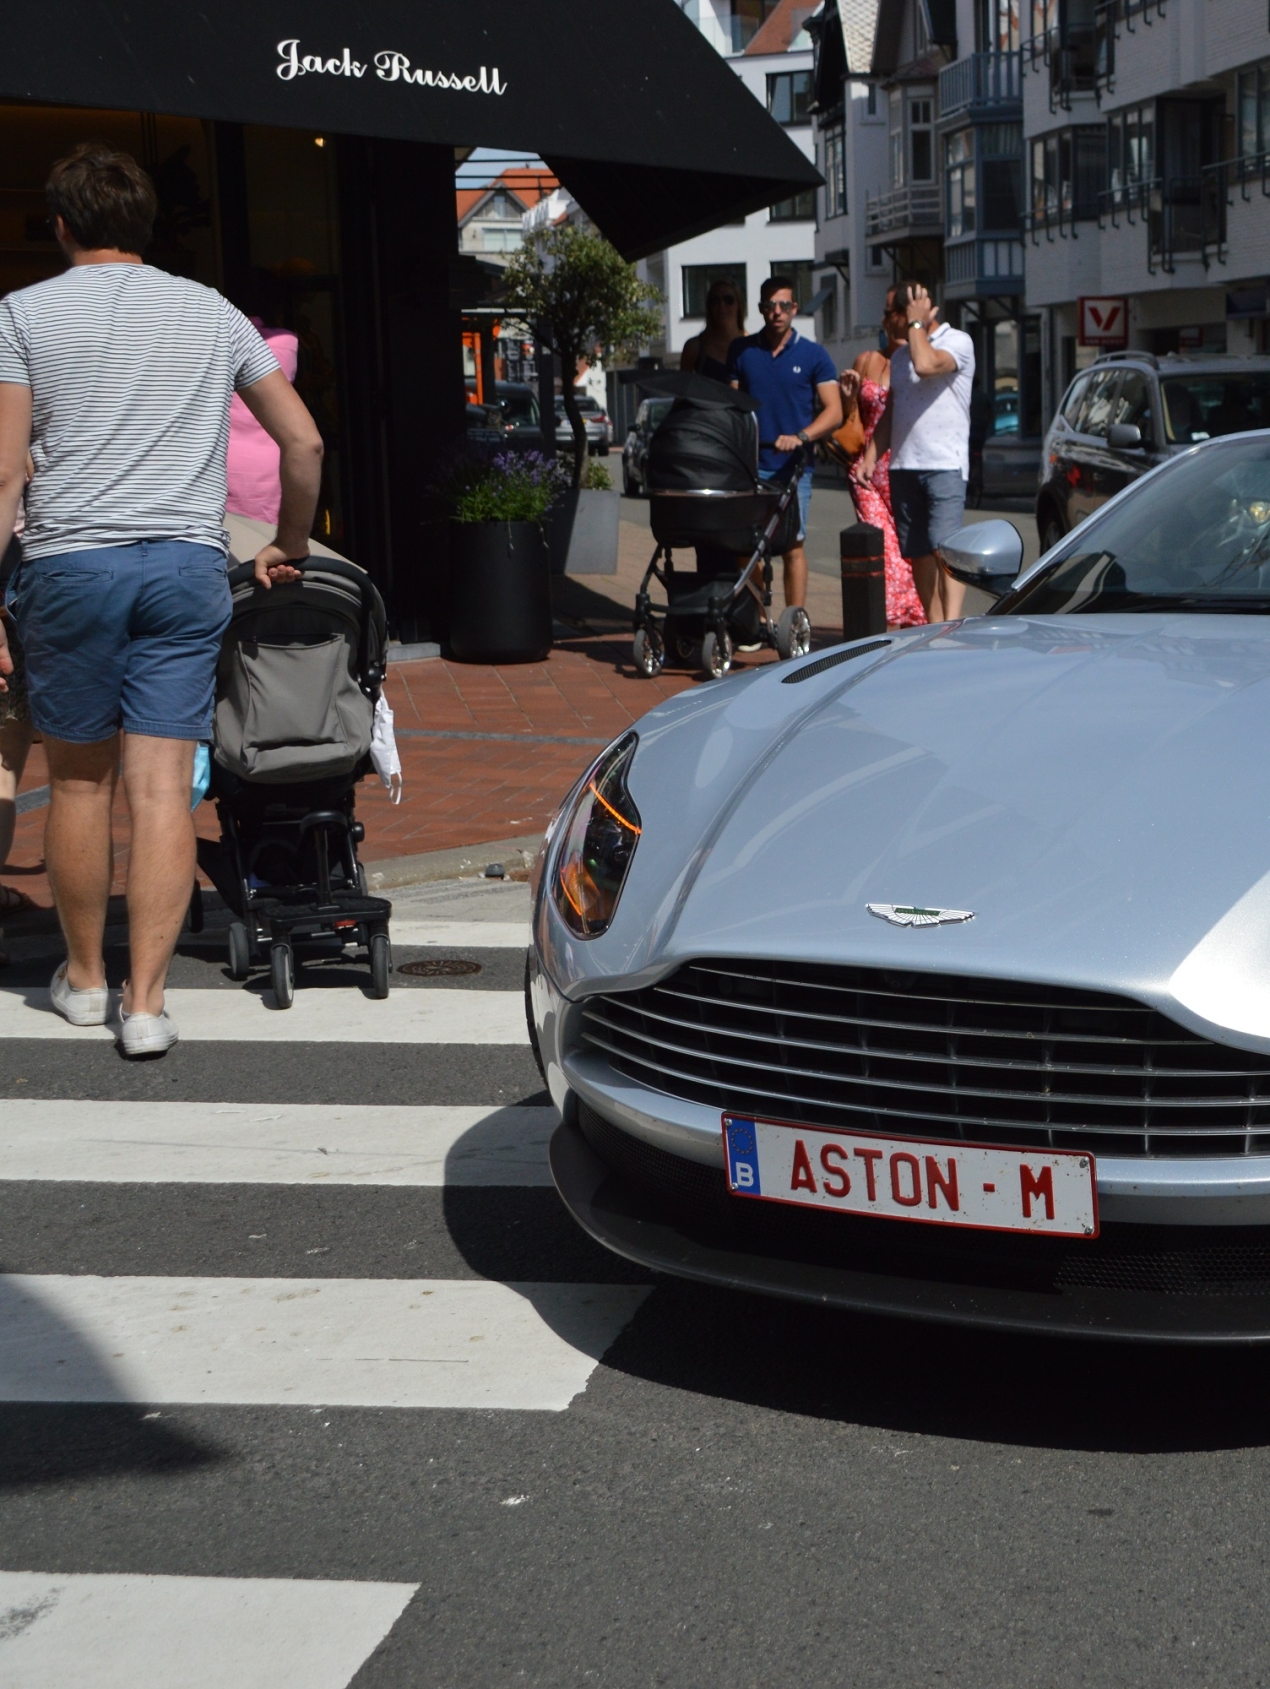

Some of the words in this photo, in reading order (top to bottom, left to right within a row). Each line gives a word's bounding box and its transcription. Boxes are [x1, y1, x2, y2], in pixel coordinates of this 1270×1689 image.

[276, 38, 368, 81] Jack
[373, 50, 508, 96] Russell
[735, 1162, 754, 1187] B
[790, 1139, 960, 1212] ASTON
[1019, 1163, 1056, 1220] M
